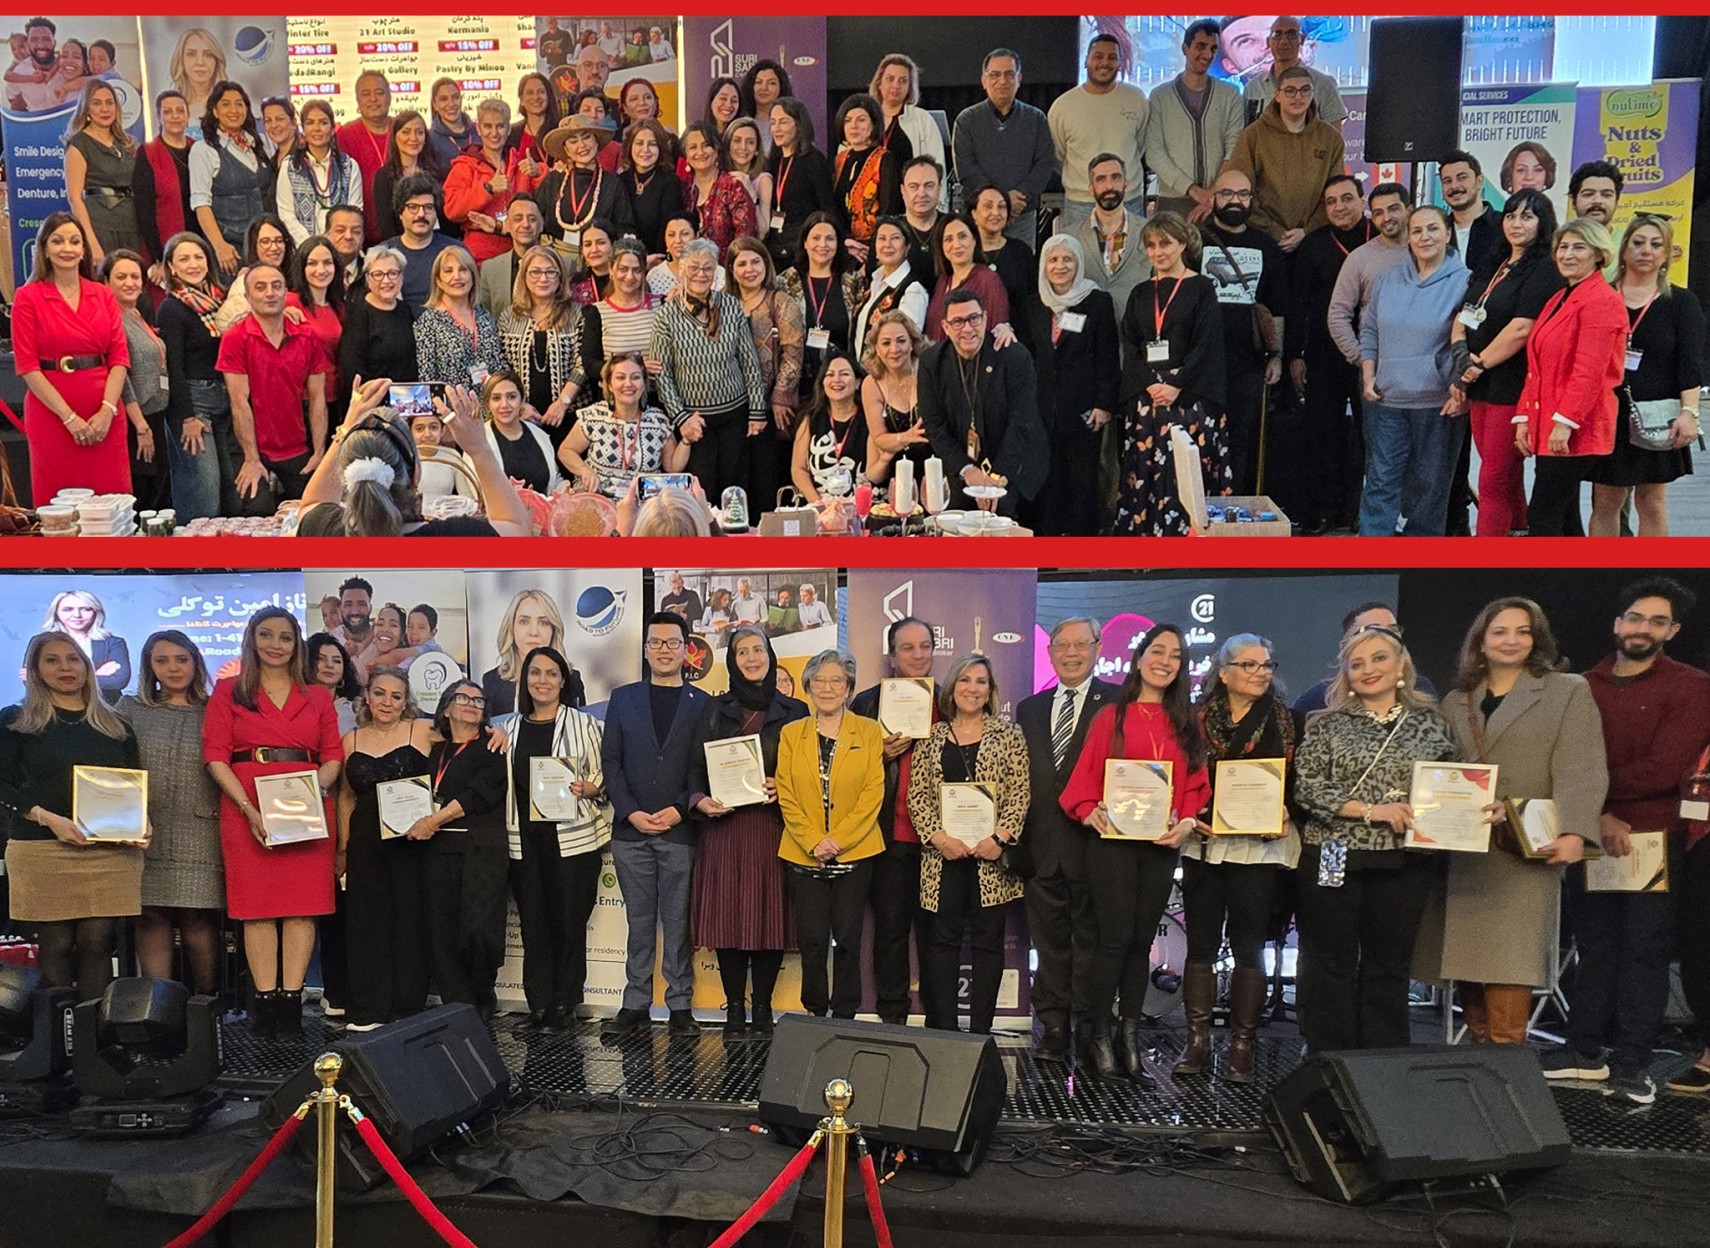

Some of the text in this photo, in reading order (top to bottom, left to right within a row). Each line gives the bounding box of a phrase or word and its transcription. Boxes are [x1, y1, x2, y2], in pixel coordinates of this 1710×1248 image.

[388, 26, 416, 35] Studio
[448, 25, 490, 34] Kermania
[388, 66, 418, 74] Gallery
[436, 65, 462, 74] Pastry
[466, 65, 476, 74] By
[1478, 90, 1508, 100] SERVICES
[1492, 109, 1562, 124] PROTECTION,
[1466, 126, 1548, 142] BRIGHT FUTURE
[1608, 126, 1662, 141] Nuts
[14, 146, 39, 157] Smile
[1629, 142, 1642, 154] &
[1608, 154, 1656, 168] Dried
[16, 166, 65, 180] Emergency
[17, 188, 58, 199] Denture,
[157, 596, 224, 618] توکلی
[598, 896, 625, 908] Entry
[594, 947, 626, 956] residency
